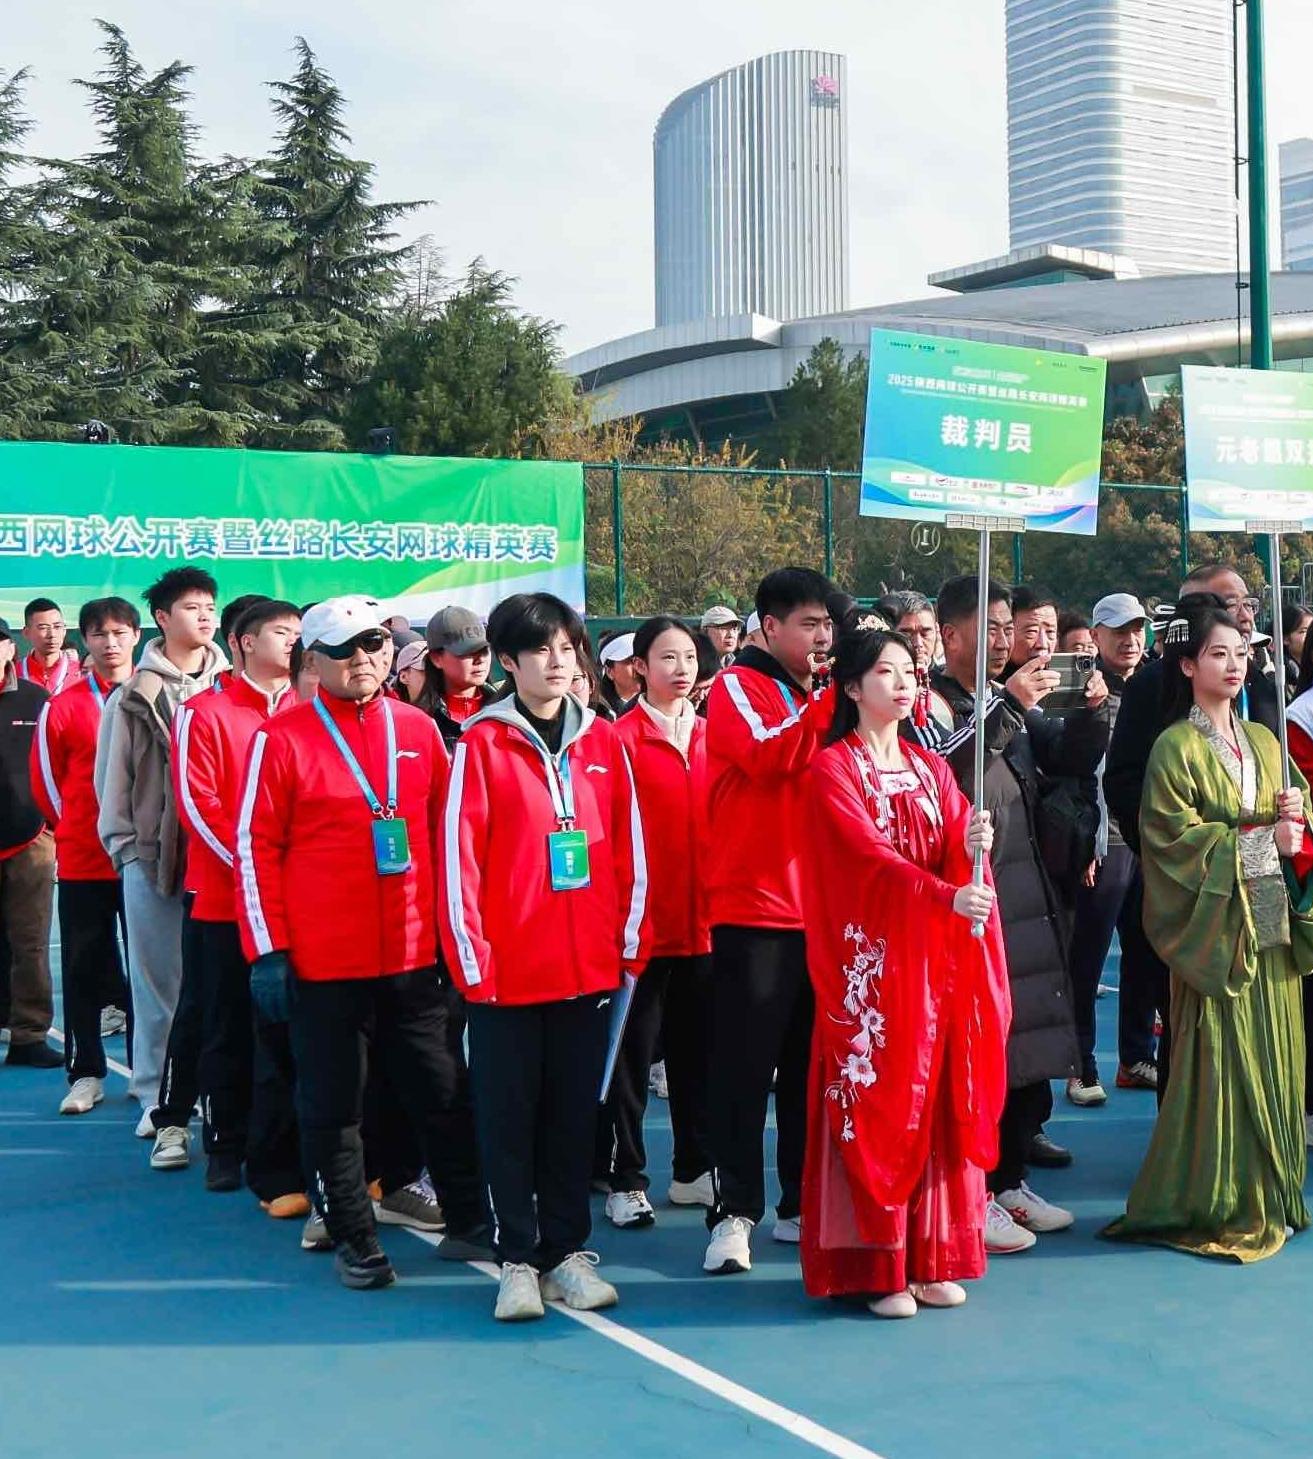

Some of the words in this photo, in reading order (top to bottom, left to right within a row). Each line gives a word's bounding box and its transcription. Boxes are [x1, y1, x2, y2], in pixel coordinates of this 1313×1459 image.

[940, 414, 1033, 454] 裁判员
[0, 514, 557, 563] 西网球公开赛暨丝路长安网球精英赛
